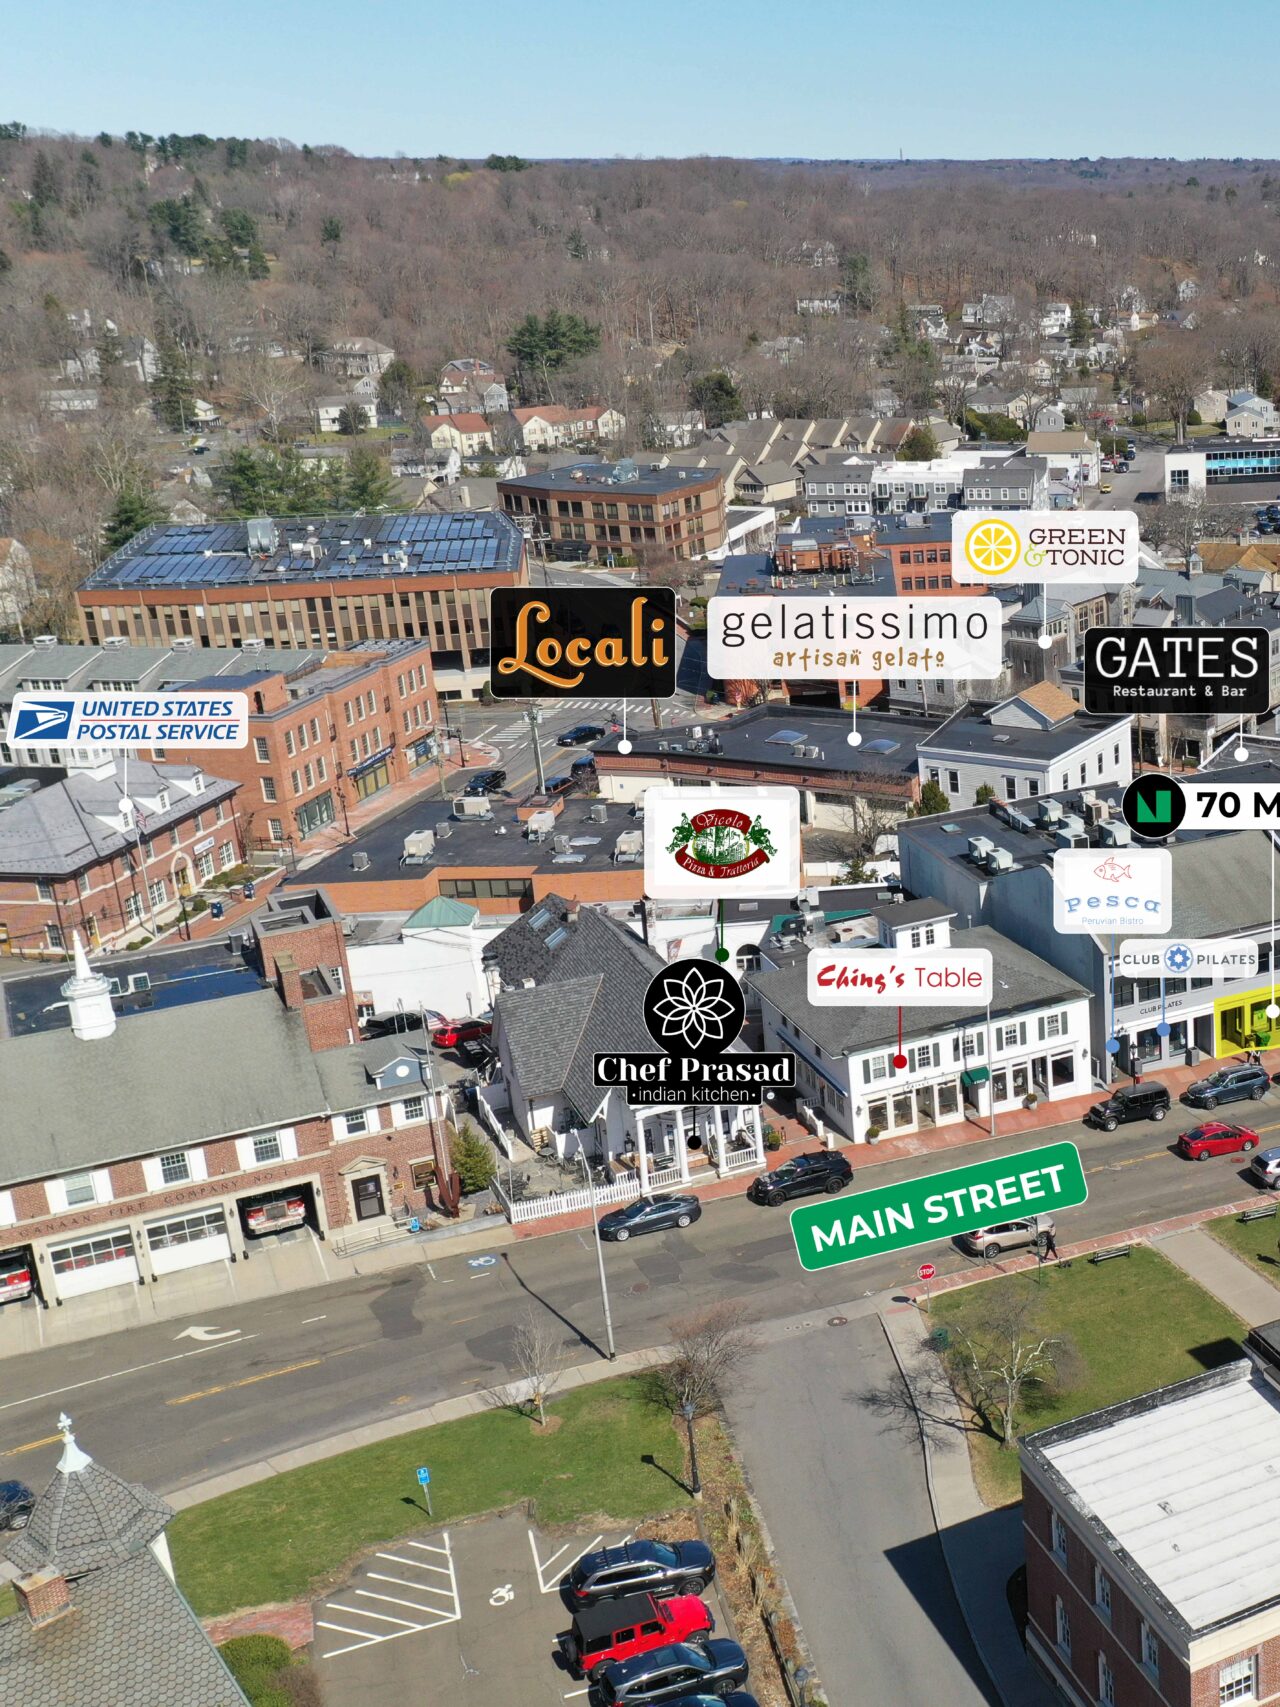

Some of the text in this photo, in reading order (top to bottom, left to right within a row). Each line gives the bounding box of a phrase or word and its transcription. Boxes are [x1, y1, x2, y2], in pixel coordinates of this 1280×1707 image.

[1139, 1000, 1183, 1015] CLUB PATES
[919, 1267, 934, 1277] STOP
